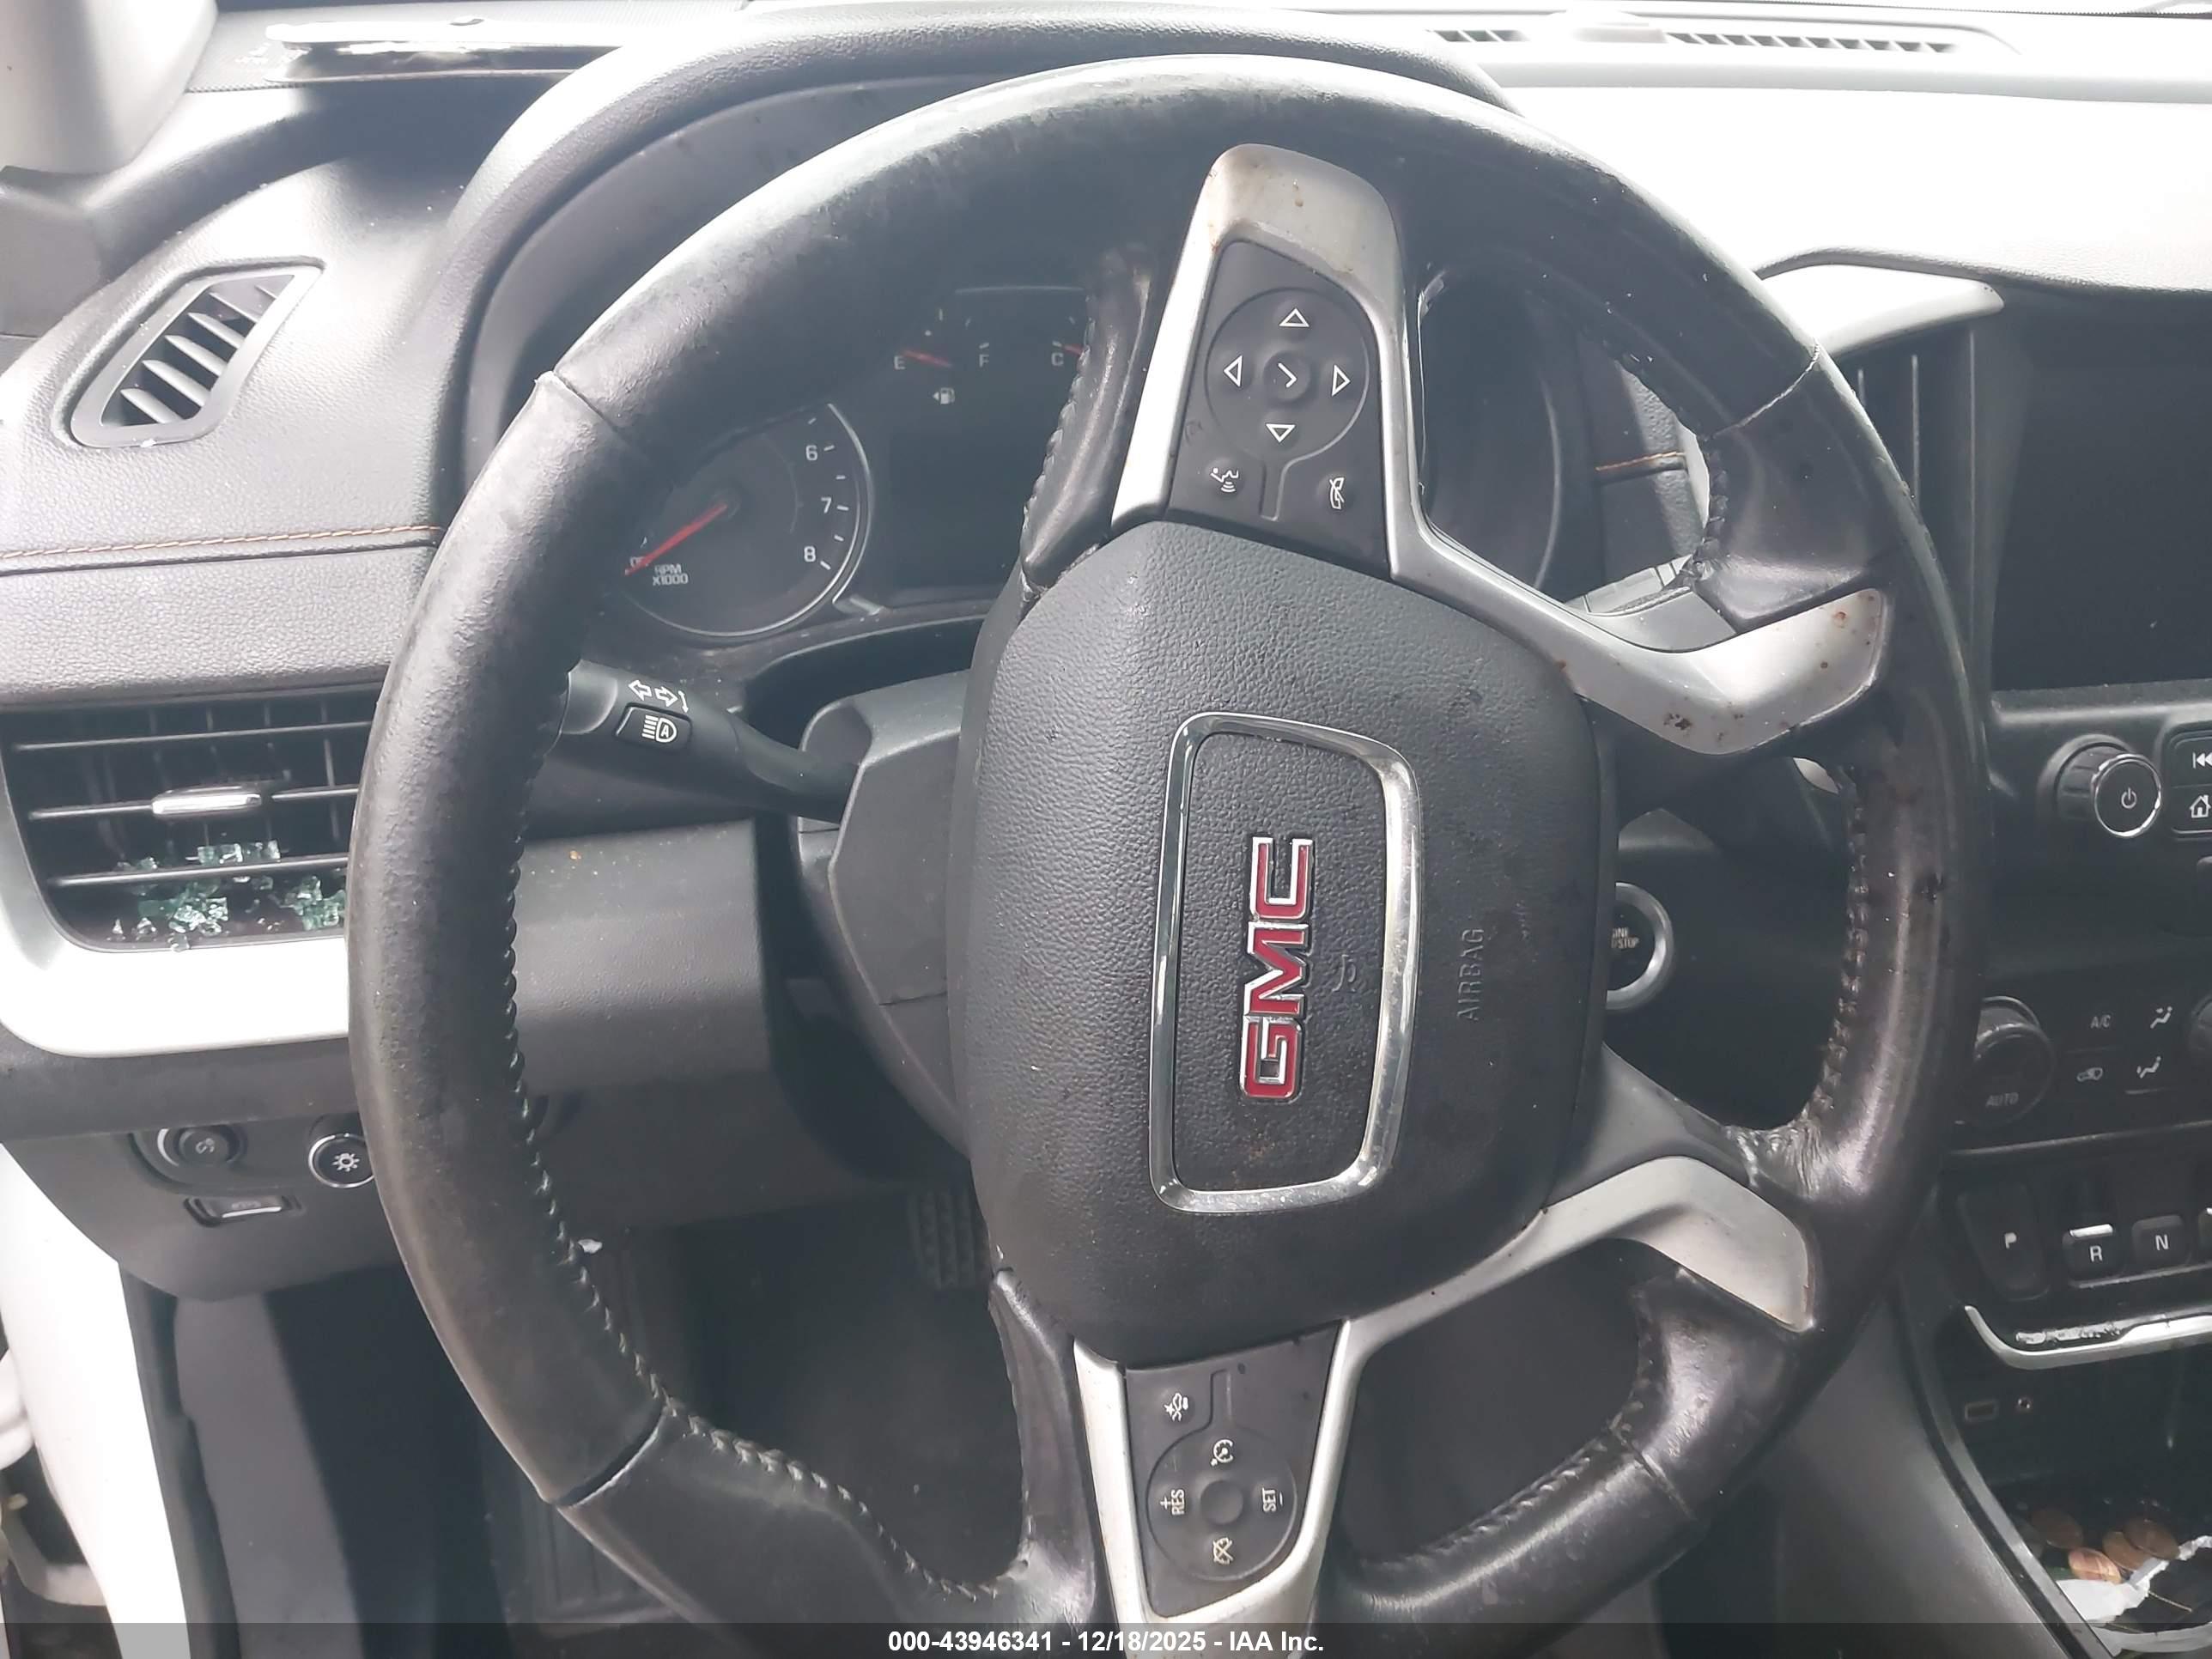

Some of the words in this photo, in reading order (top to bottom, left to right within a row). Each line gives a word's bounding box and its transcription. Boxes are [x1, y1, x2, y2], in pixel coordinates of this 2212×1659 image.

[894, 356, 905, 370] E
[979, 354, 990, 368] F
[1051, 352, 1064, 367] C
[805, 445, 818, 461] 6
[821, 496, 832, 514] 7
[804, 546, 816, 562] 8
[654, 563, 682, 575] RPM
[1239, 836, 1315, 1100] GMC
[1457, 928, 1485, 1021] AIRBAG
[2090, 1014, 2112, 1029] A/C
[1986, 1091, 2020, 1108] AUTO
[2004, 1232, 2017, 1249] P
[2155, 1234, 2169, 1251] N
[2089, 1245, 2103, 1262] R
[1171, 1488, 1185, 1516] RES
[1261, 1487, 1277, 1512] SET
